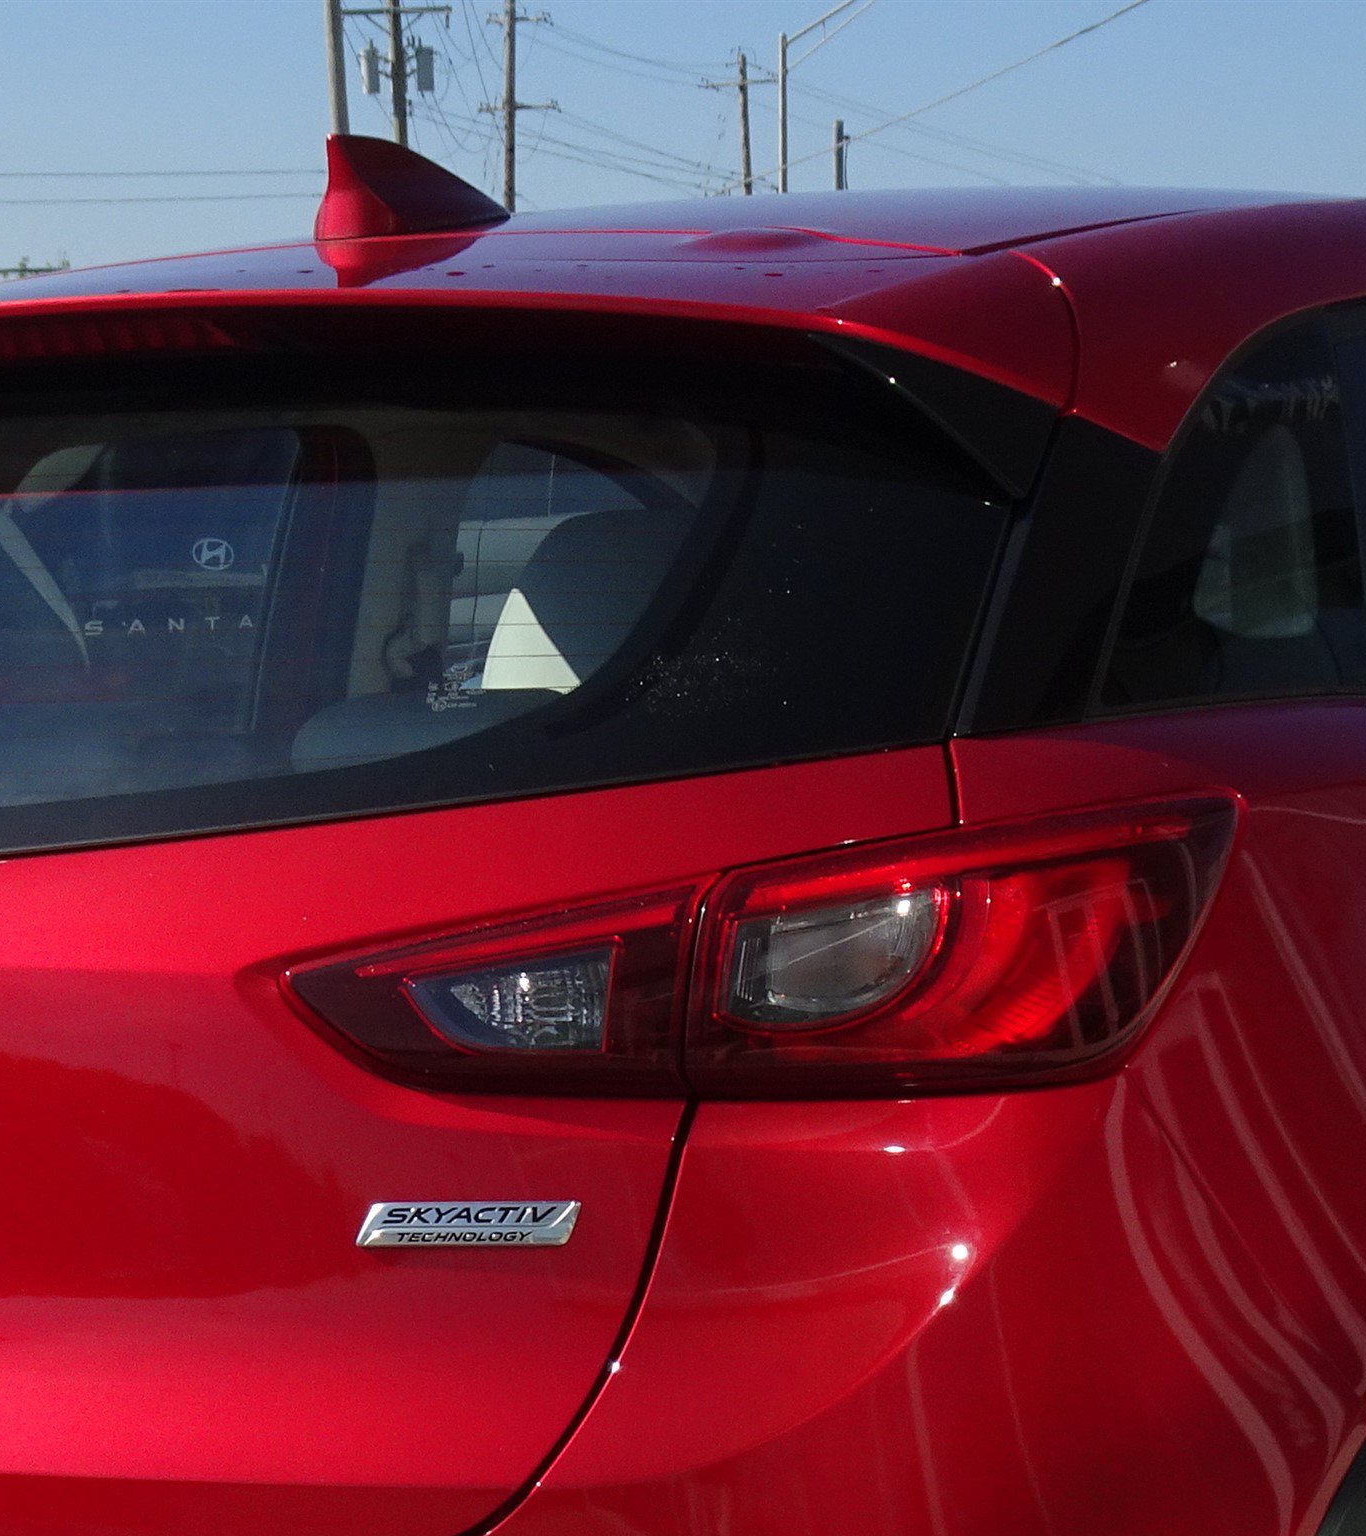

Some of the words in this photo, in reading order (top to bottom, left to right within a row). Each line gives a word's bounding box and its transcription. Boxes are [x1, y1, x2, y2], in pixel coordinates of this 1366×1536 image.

[83, 613, 254, 637] SANTA
[382, 1206, 557, 1224] SKYACTIV
[396, 1231, 532, 1242] TECHNOLOGY
